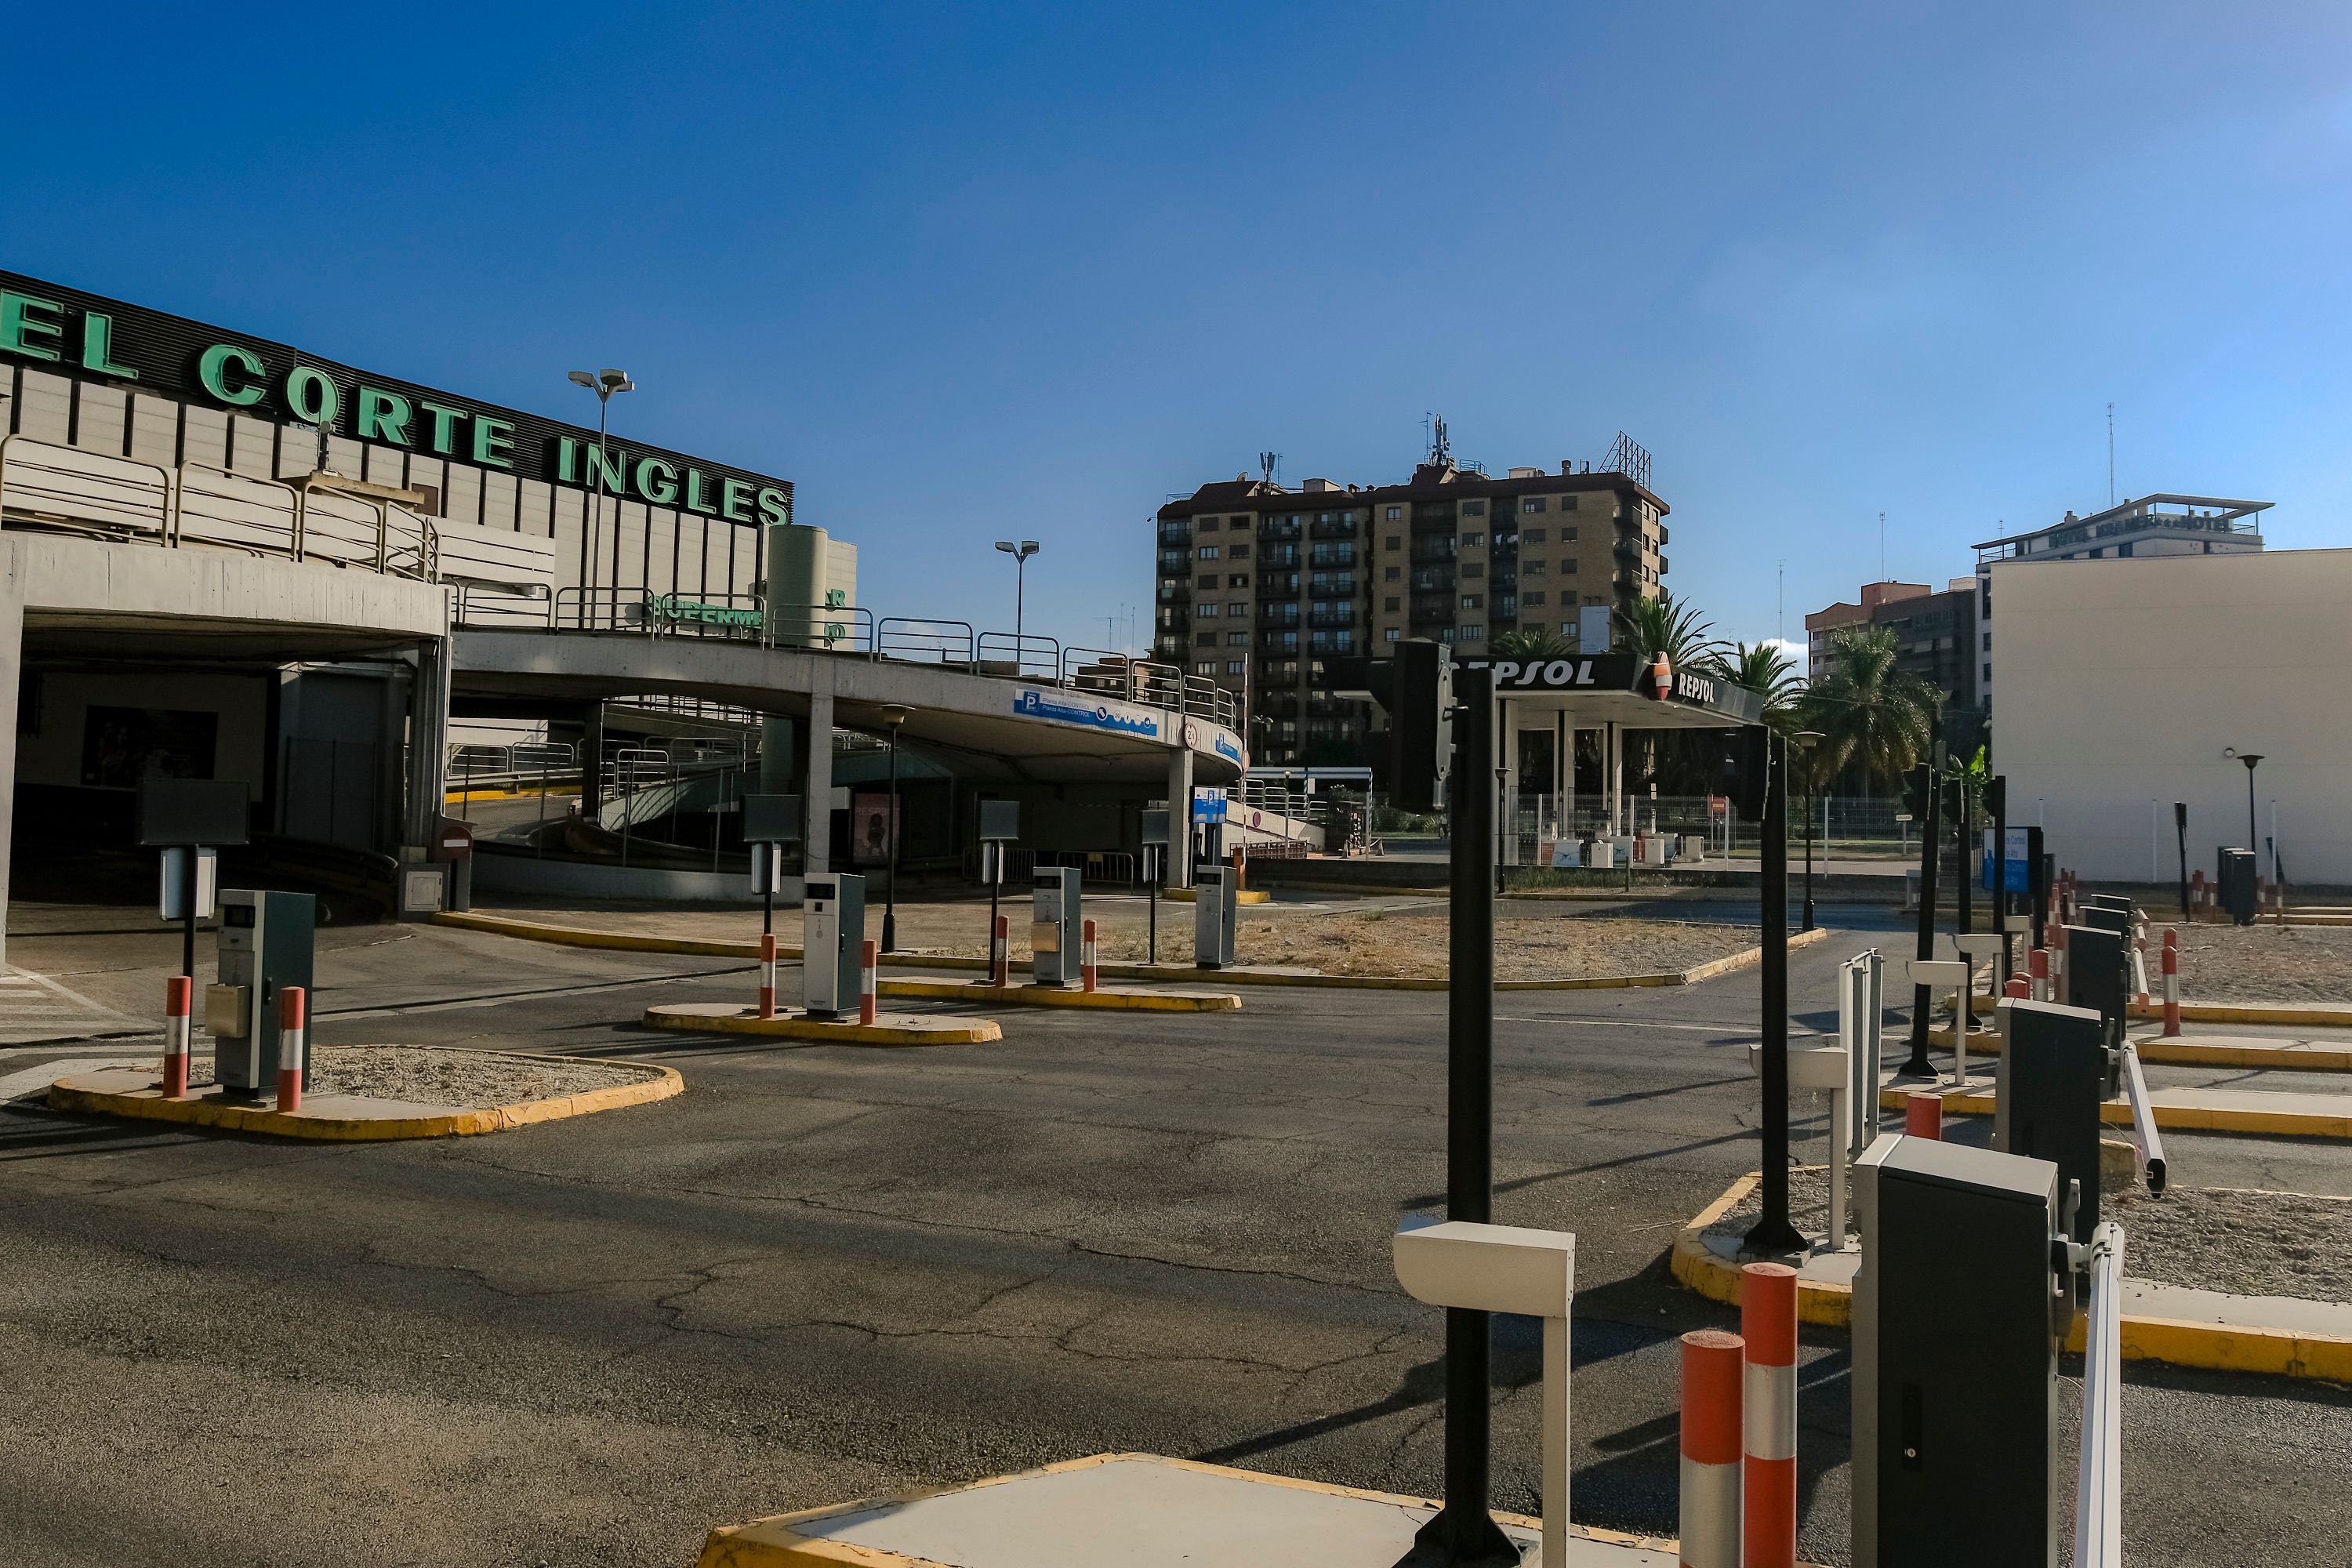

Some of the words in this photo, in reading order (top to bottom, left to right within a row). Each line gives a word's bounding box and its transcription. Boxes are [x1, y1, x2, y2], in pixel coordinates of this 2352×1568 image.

[0, 289, 139, 379] EL
[199, 343, 515, 468] CORTE
[558, 435, 789, 526] INGLES
[1450, 661, 1595, 685] PSOL
[1679, 673, 1715, 703] REPSOL
[1058, 708, 1091, 718] Alta-CONTROL
